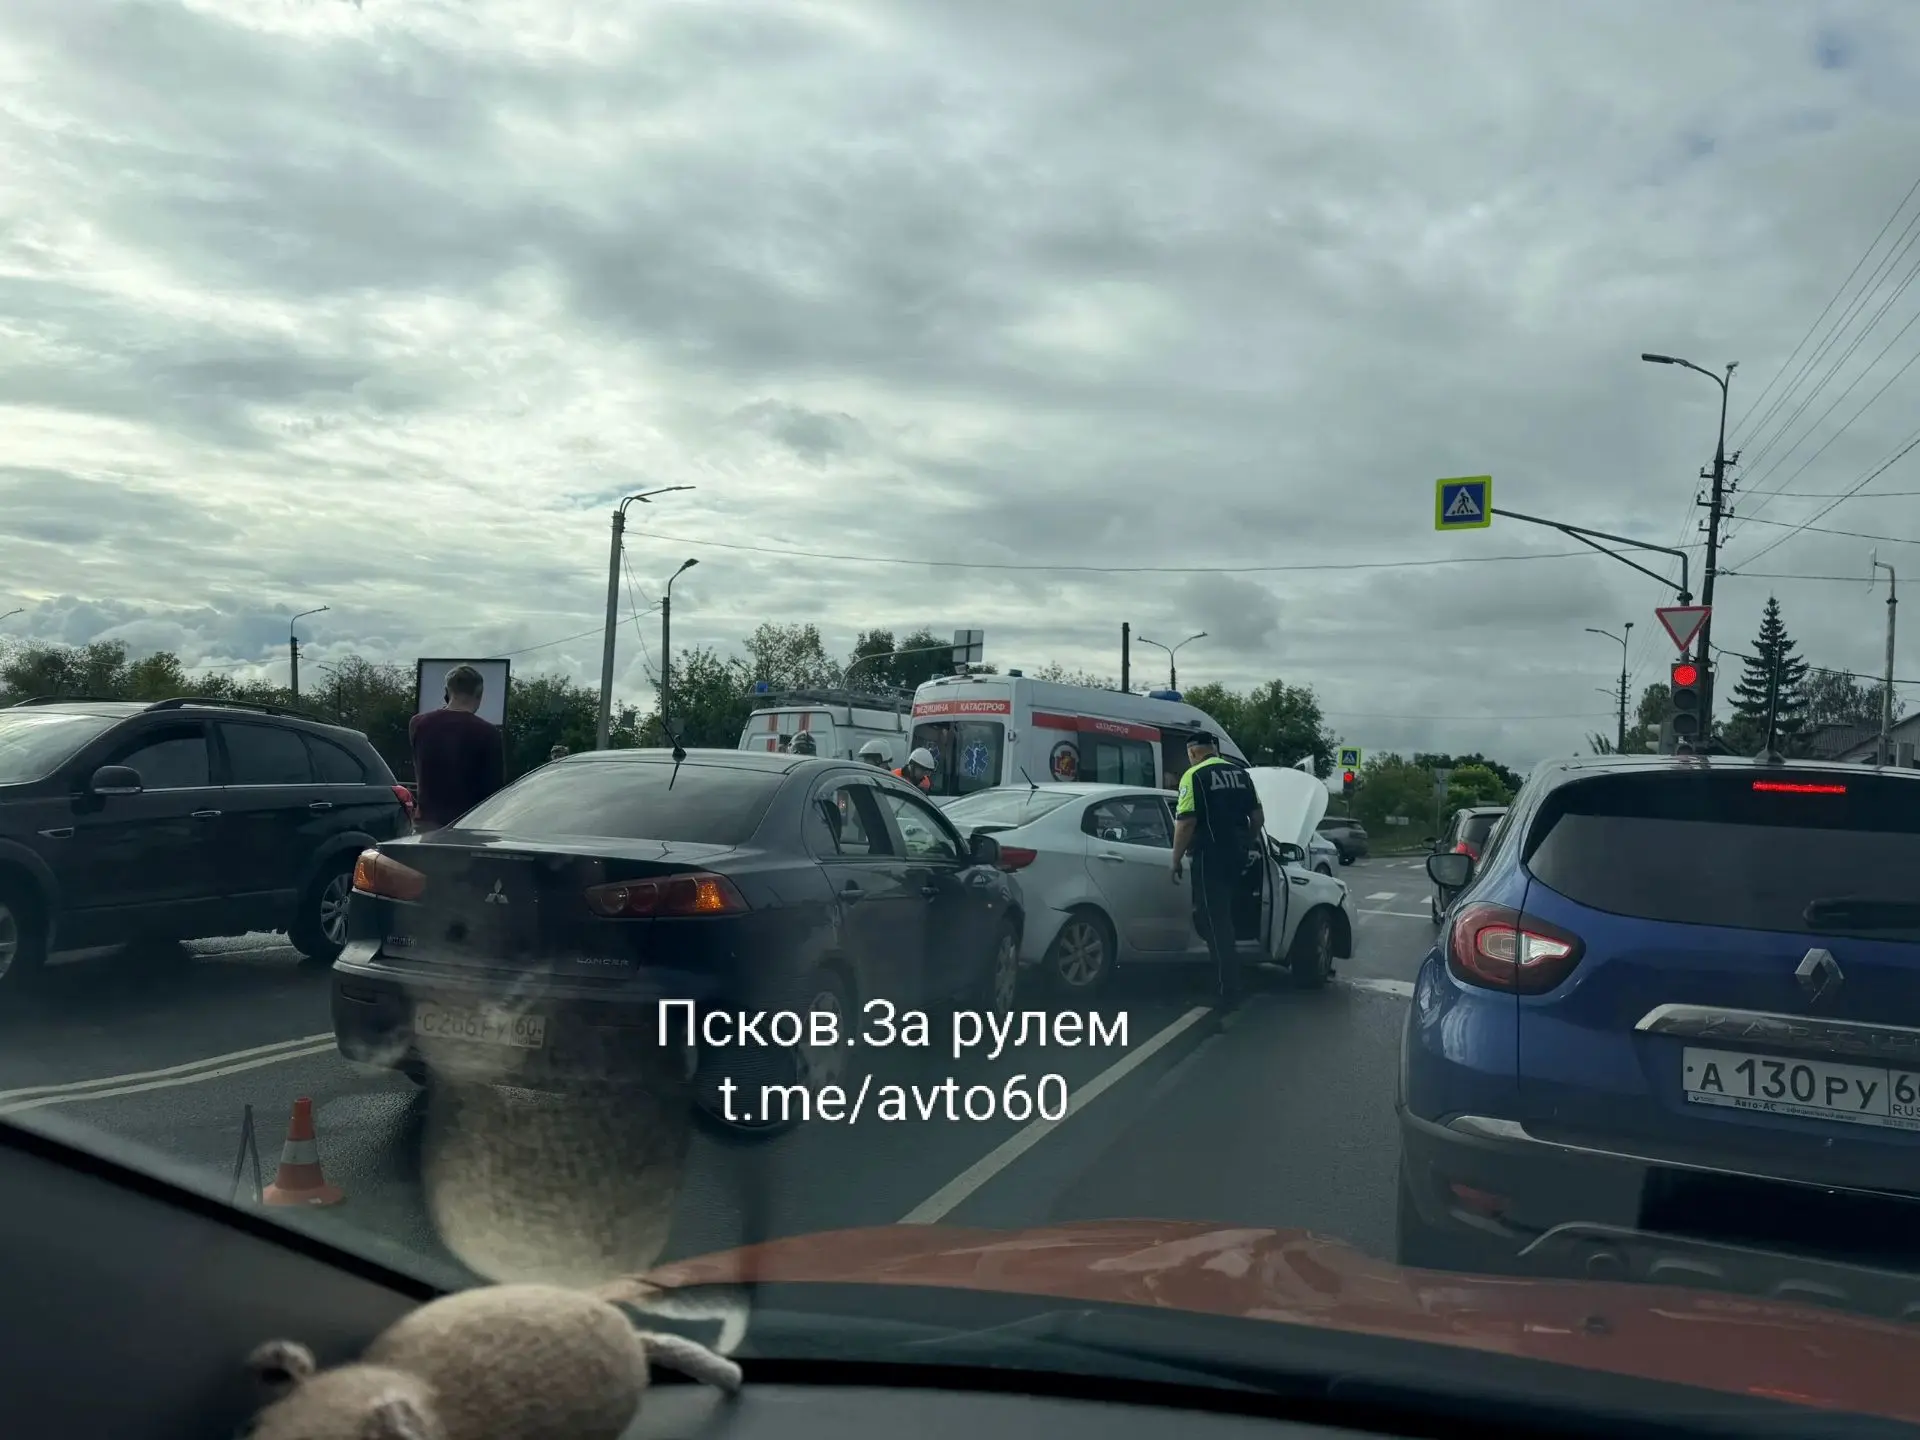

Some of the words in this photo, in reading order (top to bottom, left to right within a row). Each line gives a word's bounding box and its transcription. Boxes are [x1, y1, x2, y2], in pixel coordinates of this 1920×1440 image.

[915, 703, 949, 716] МЕДИЦИНА
[960, 702, 1005, 712] КАТАСТРОФ
[1210, 769, 1247, 790] ДПС
[576, 957, 630, 967] LANCER
[1894, 1074, 1920, 1104] 6
[1734, 1099, 1777, 1111] Авто-АС
